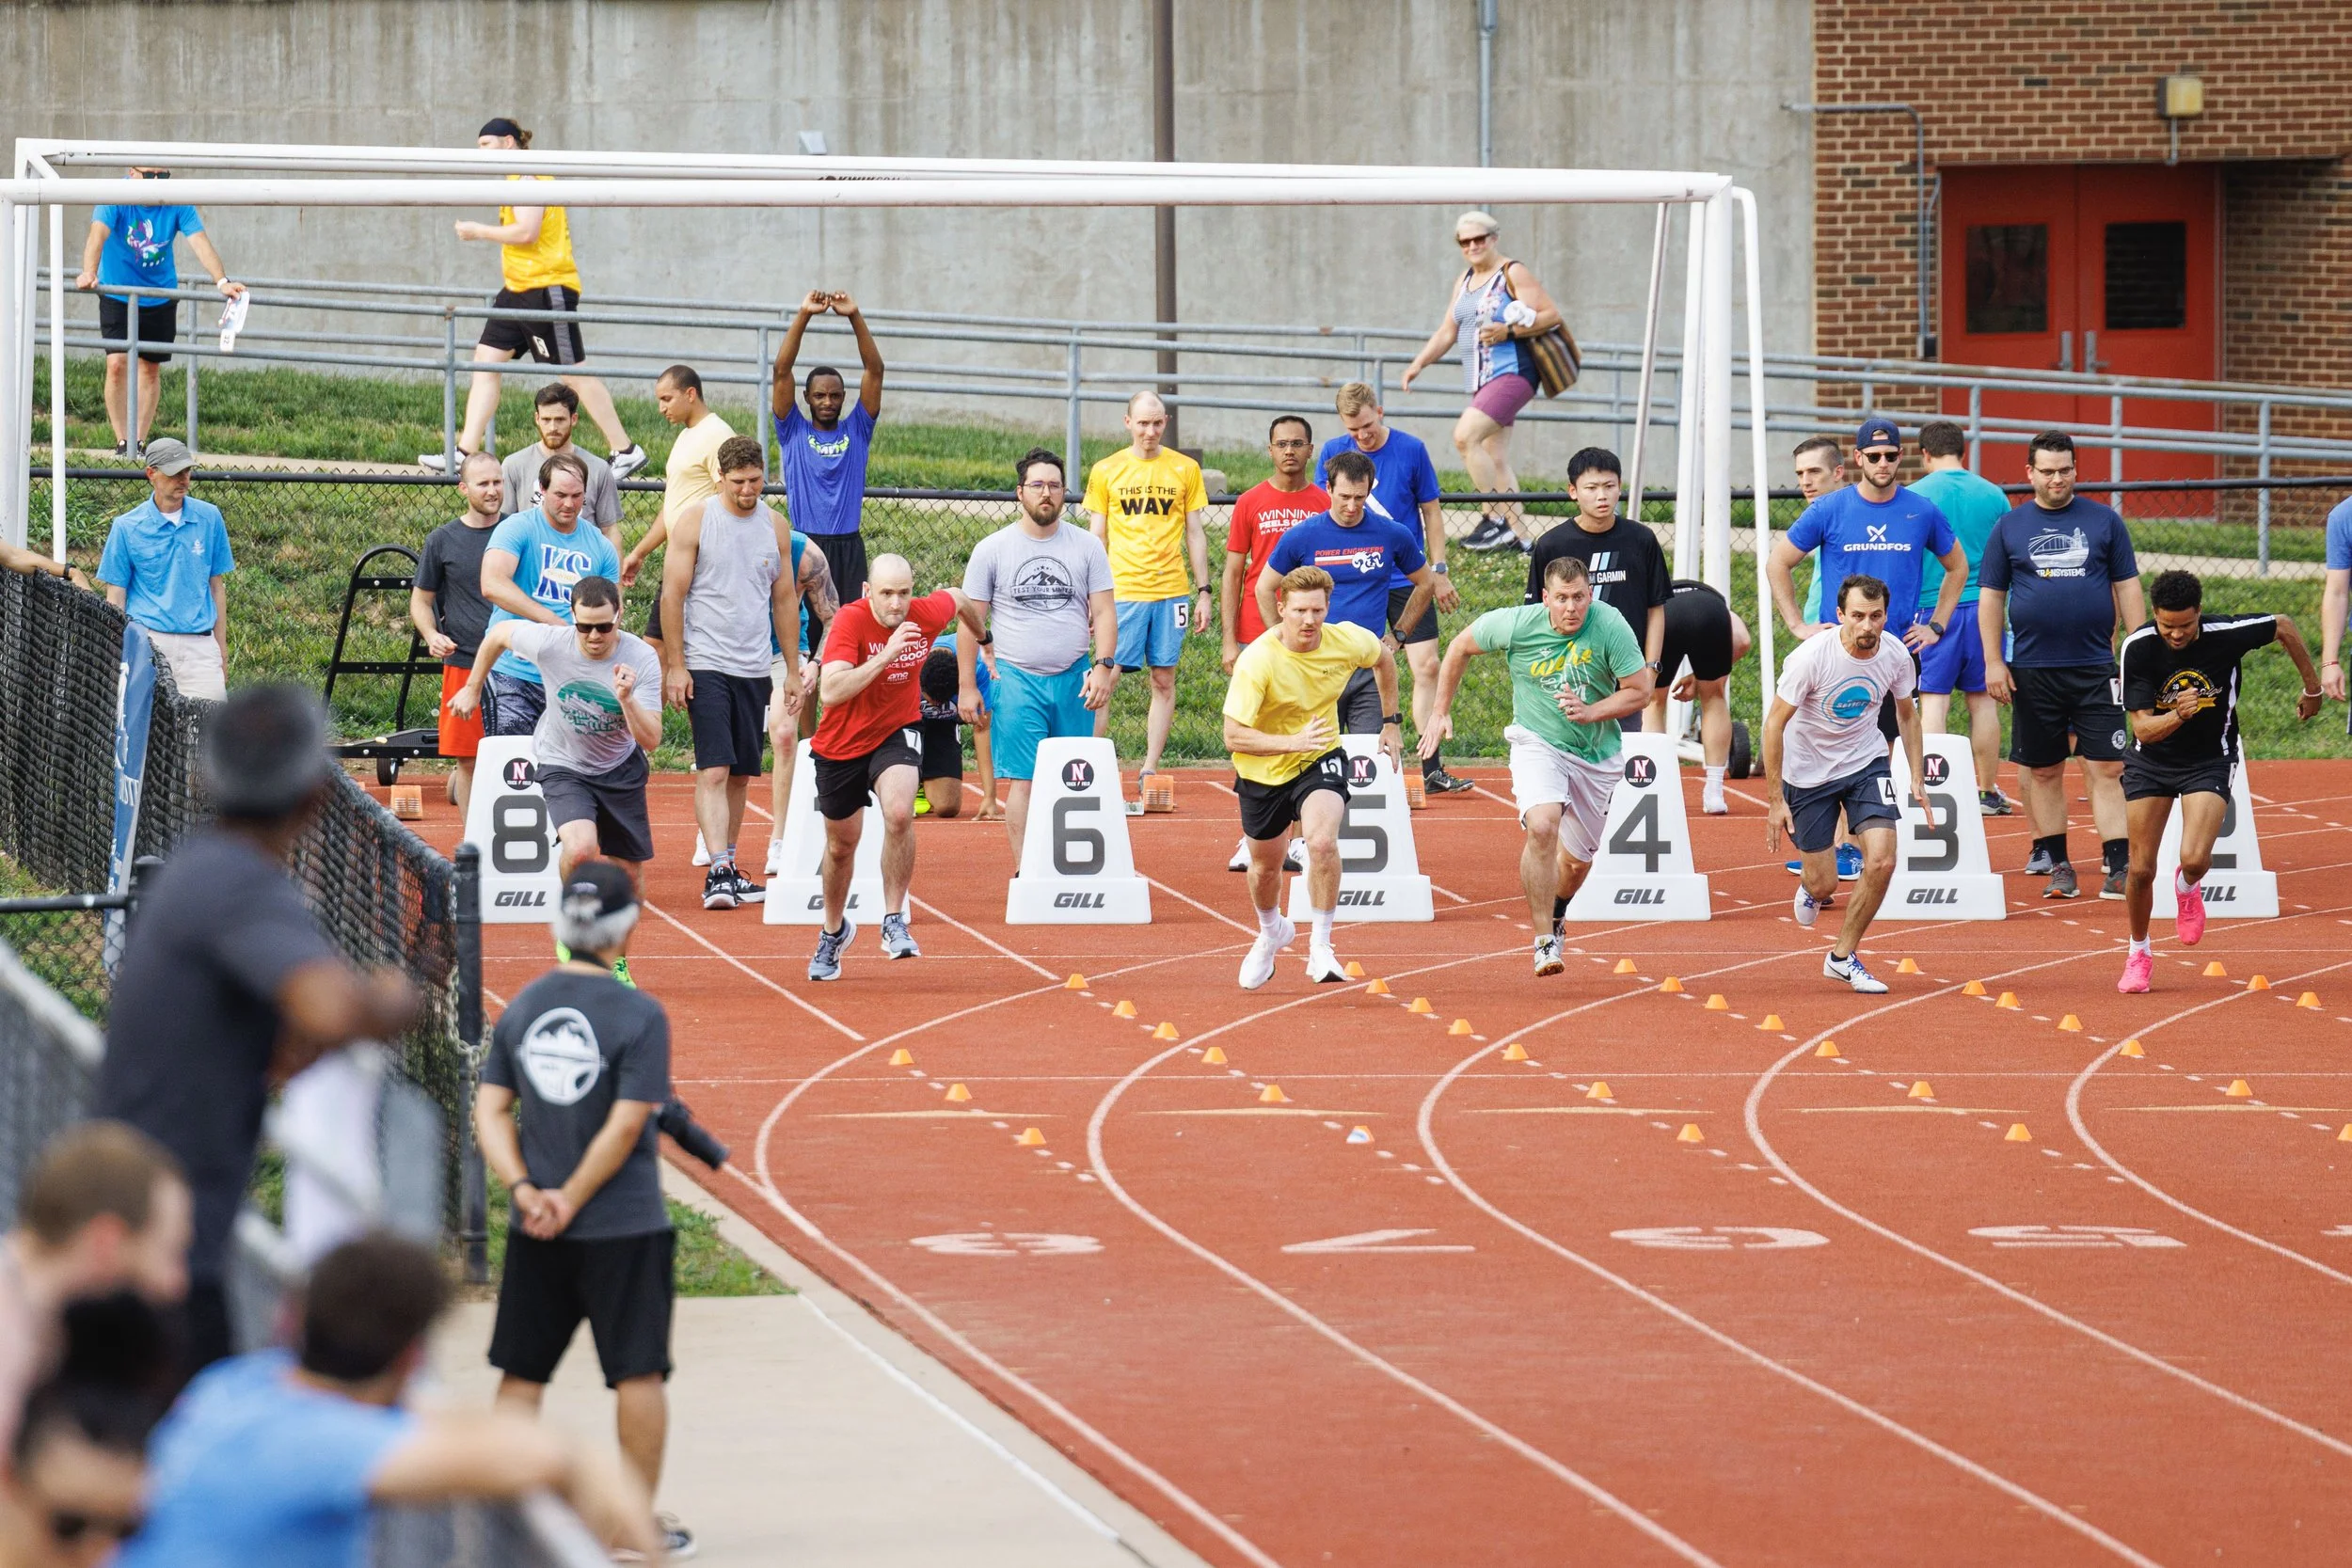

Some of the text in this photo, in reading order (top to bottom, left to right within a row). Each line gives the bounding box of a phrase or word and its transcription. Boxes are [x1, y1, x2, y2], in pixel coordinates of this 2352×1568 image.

[1118, 486, 1141, 495] THIS
[1155, 486, 1176, 495] THE
[1120, 498, 1175, 515] WAY
[1314, 548, 1341, 557] POWER
[1843, 543, 1911, 552] GRUNDFOS
[1597, 570, 1626, 583] GARMIN
[2035, 568, 2086, 578] TRANSYSTEMS
[1178, 605, 1186, 626] 5
[899, 648, 929, 662] GOOD
[909, 729, 918, 748] 7
[1327, 756, 1338, 774] 6
[1884, 779, 1896, 802] 4
[492, 795, 549, 873] 8
[1053, 797, 1104, 875] 6
[1337, 794, 1389, 873] 5
[1609, 794, 1671, 873] 4
[1908, 793, 1959, 871] 3
[494, 891, 547, 907] GILL
[807, 894, 859, 911] GL
[1054, 893, 1104, 908] GILL
[1337, 890, 1385, 906] GILL
[1613, 889, 1665, 904] GILL
[1906, 888, 1958, 904] GILL
